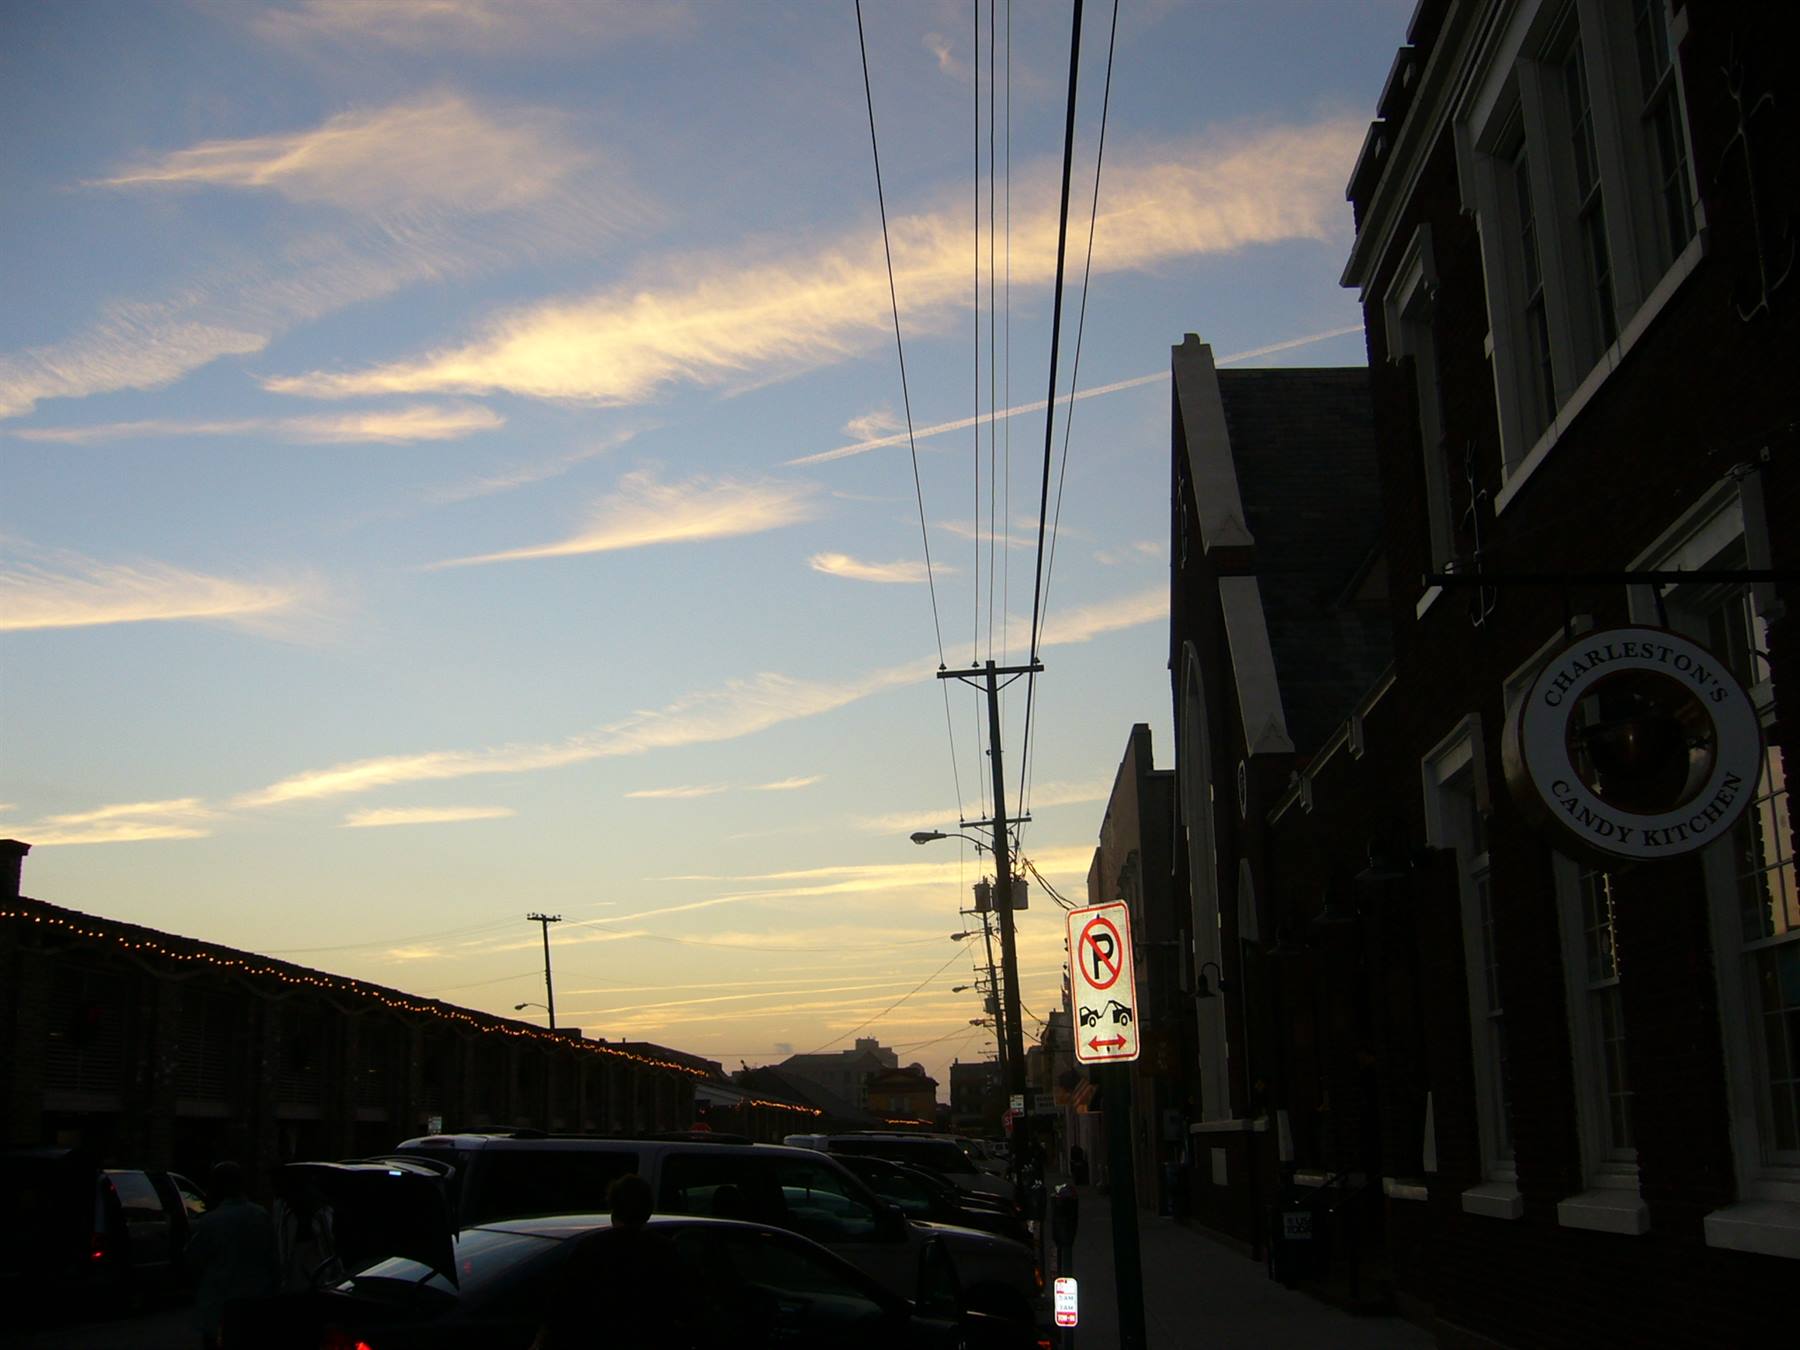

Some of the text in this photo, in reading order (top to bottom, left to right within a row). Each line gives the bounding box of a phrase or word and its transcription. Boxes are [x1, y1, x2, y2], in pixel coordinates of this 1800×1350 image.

[1544, 642, 1729, 707] CHARLESTON'S
[1551, 771, 1742, 847] CANDY KITCHEN
